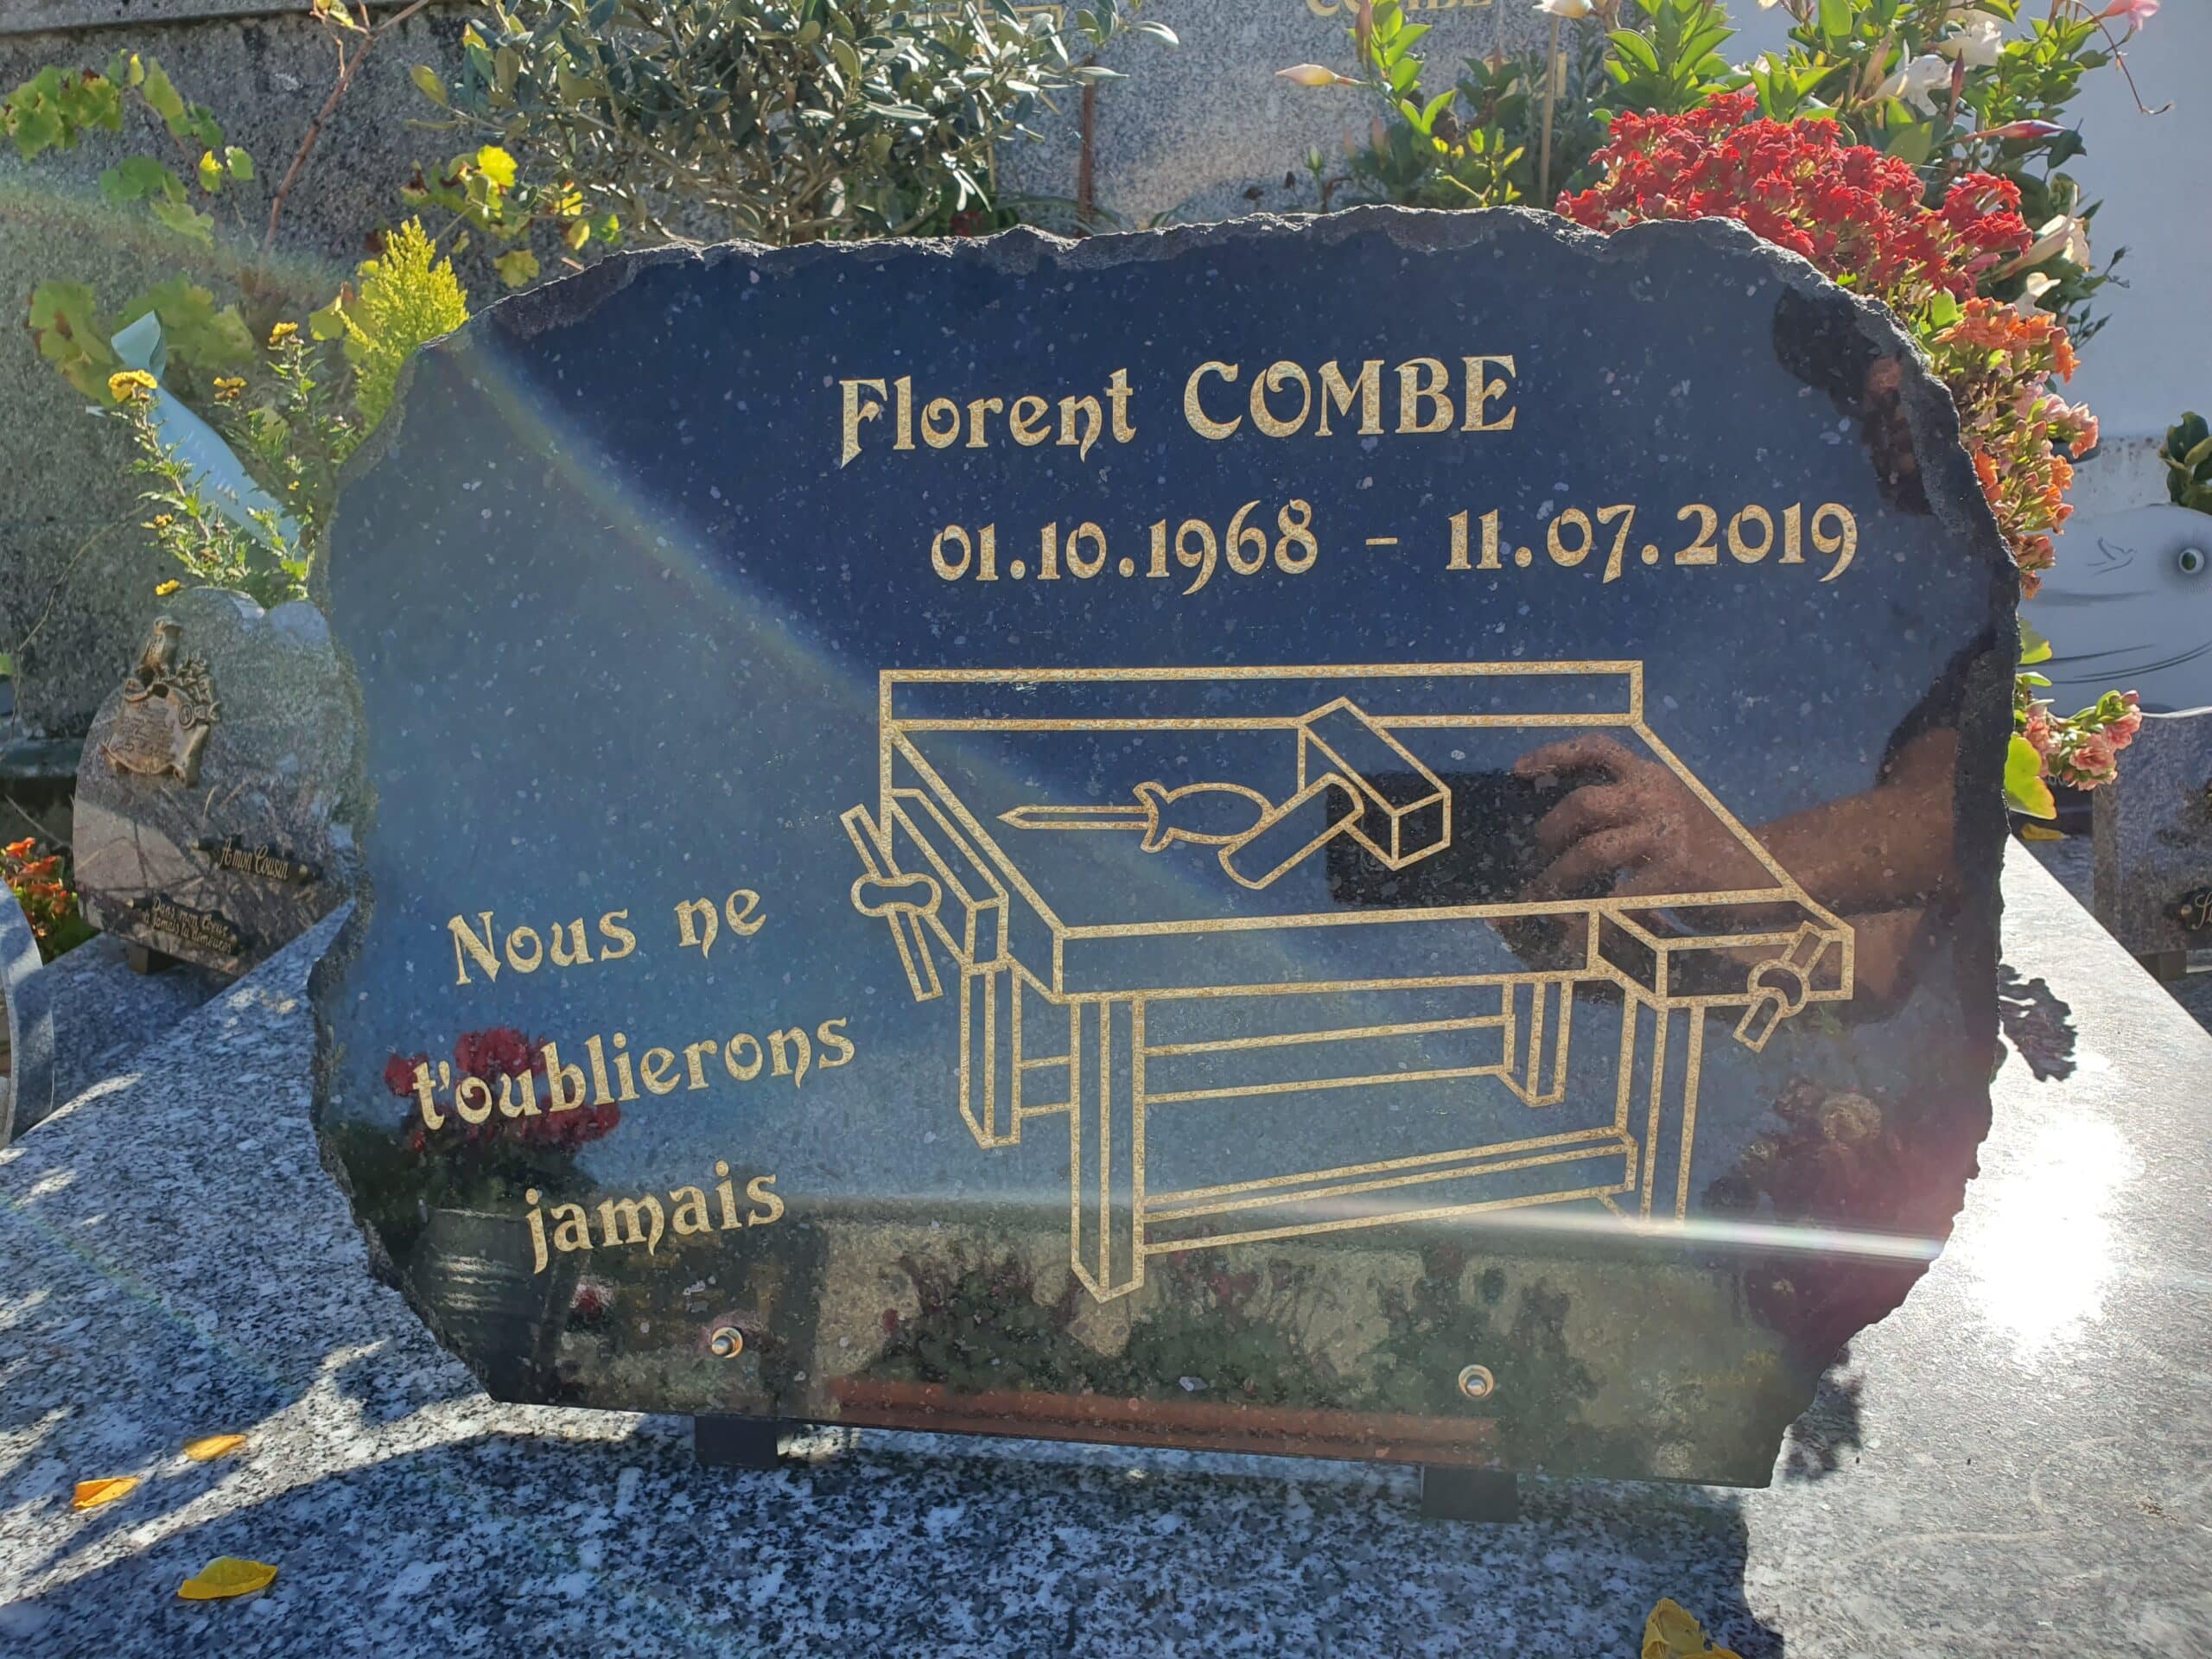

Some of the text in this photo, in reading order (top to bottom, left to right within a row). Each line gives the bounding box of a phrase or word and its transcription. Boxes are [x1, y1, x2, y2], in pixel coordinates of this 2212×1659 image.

[838, 354, 1517, 470] Florent COMBE
[931, 498, 1319, 596] 01.10.1968
[1445, 501, 1858, 584] 11.07.2019
[232, 849, 252, 872] mon
[254, 843, 289, 880] Cousin
[447, 888, 767, 986] Nous ne
[524, 1160, 785, 1275] jamais
